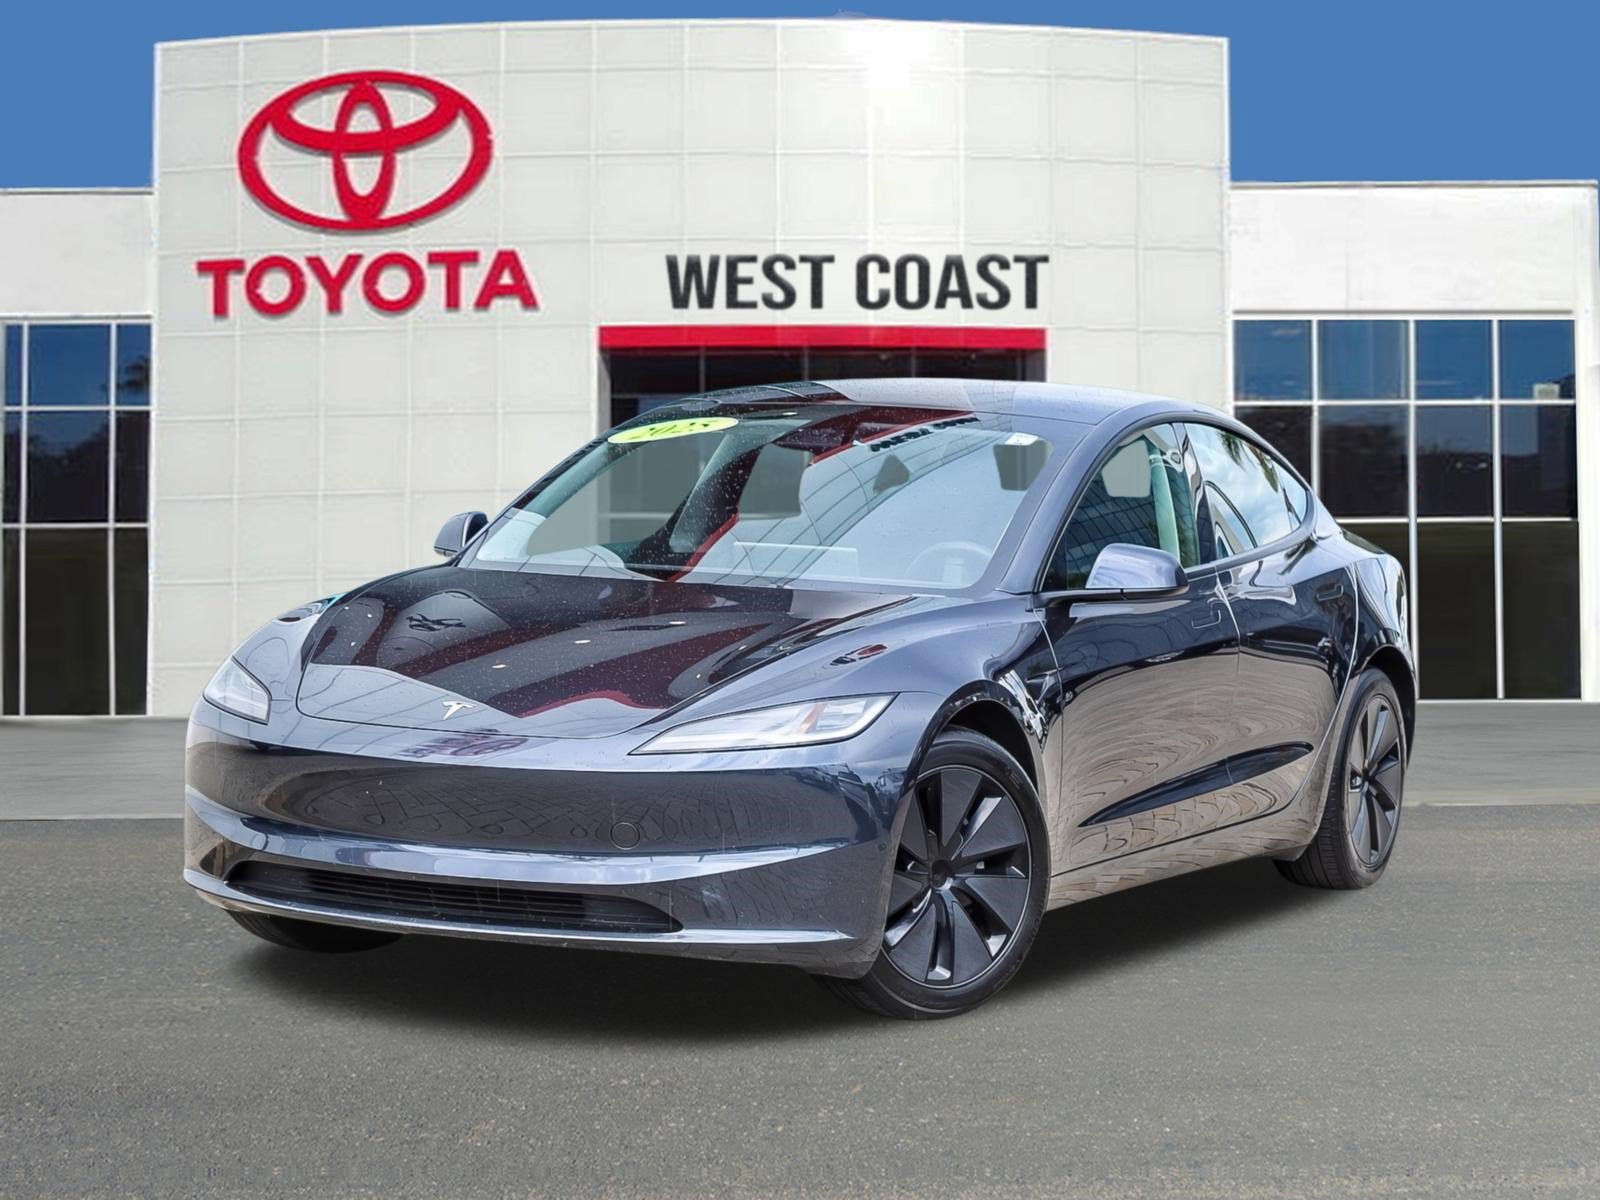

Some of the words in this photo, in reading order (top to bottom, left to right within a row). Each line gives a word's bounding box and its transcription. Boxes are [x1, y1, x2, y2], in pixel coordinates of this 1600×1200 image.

[197, 250, 538, 317] TOYOTA
[666, 254, 835, 310] WEST
[855, 254, 1050, 310] COAST
